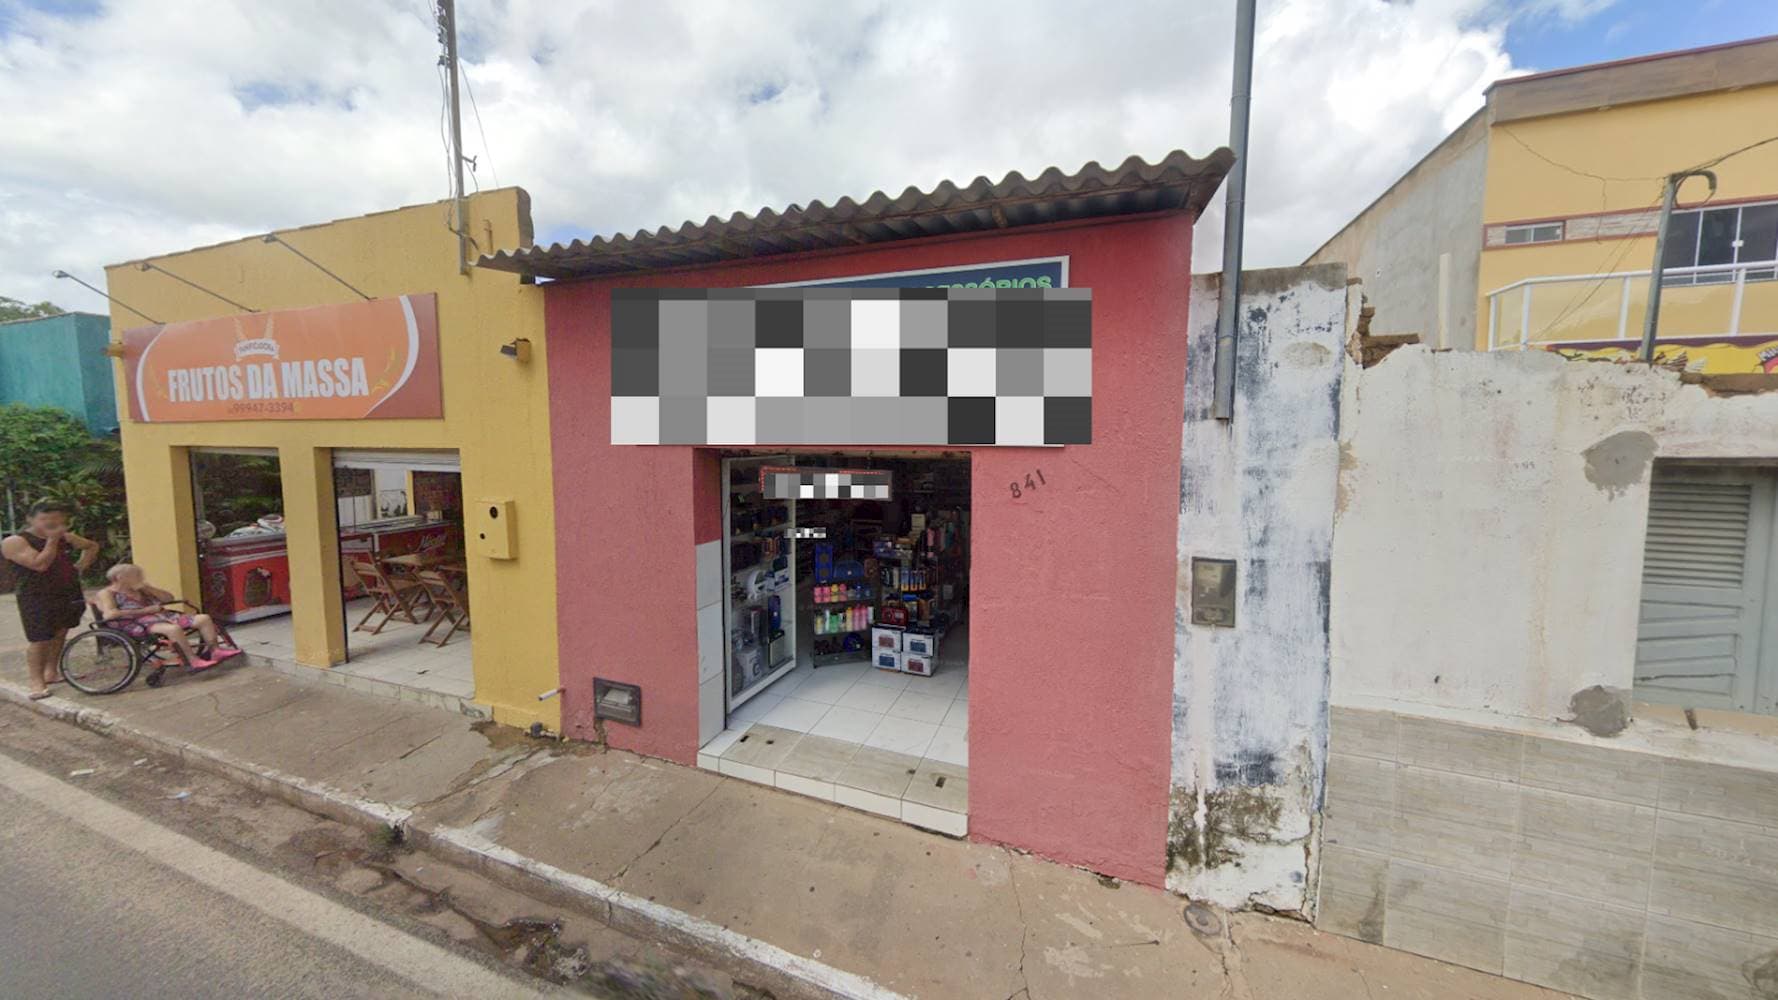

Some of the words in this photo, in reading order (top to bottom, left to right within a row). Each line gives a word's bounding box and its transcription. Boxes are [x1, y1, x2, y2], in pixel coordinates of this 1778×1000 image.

[168, 365, 244, 402] FRUTOS
[246, 363, 279, 399] DA
[281, 357, 369, 398] MASSA
[1010, 469, 1046, 499] 841
